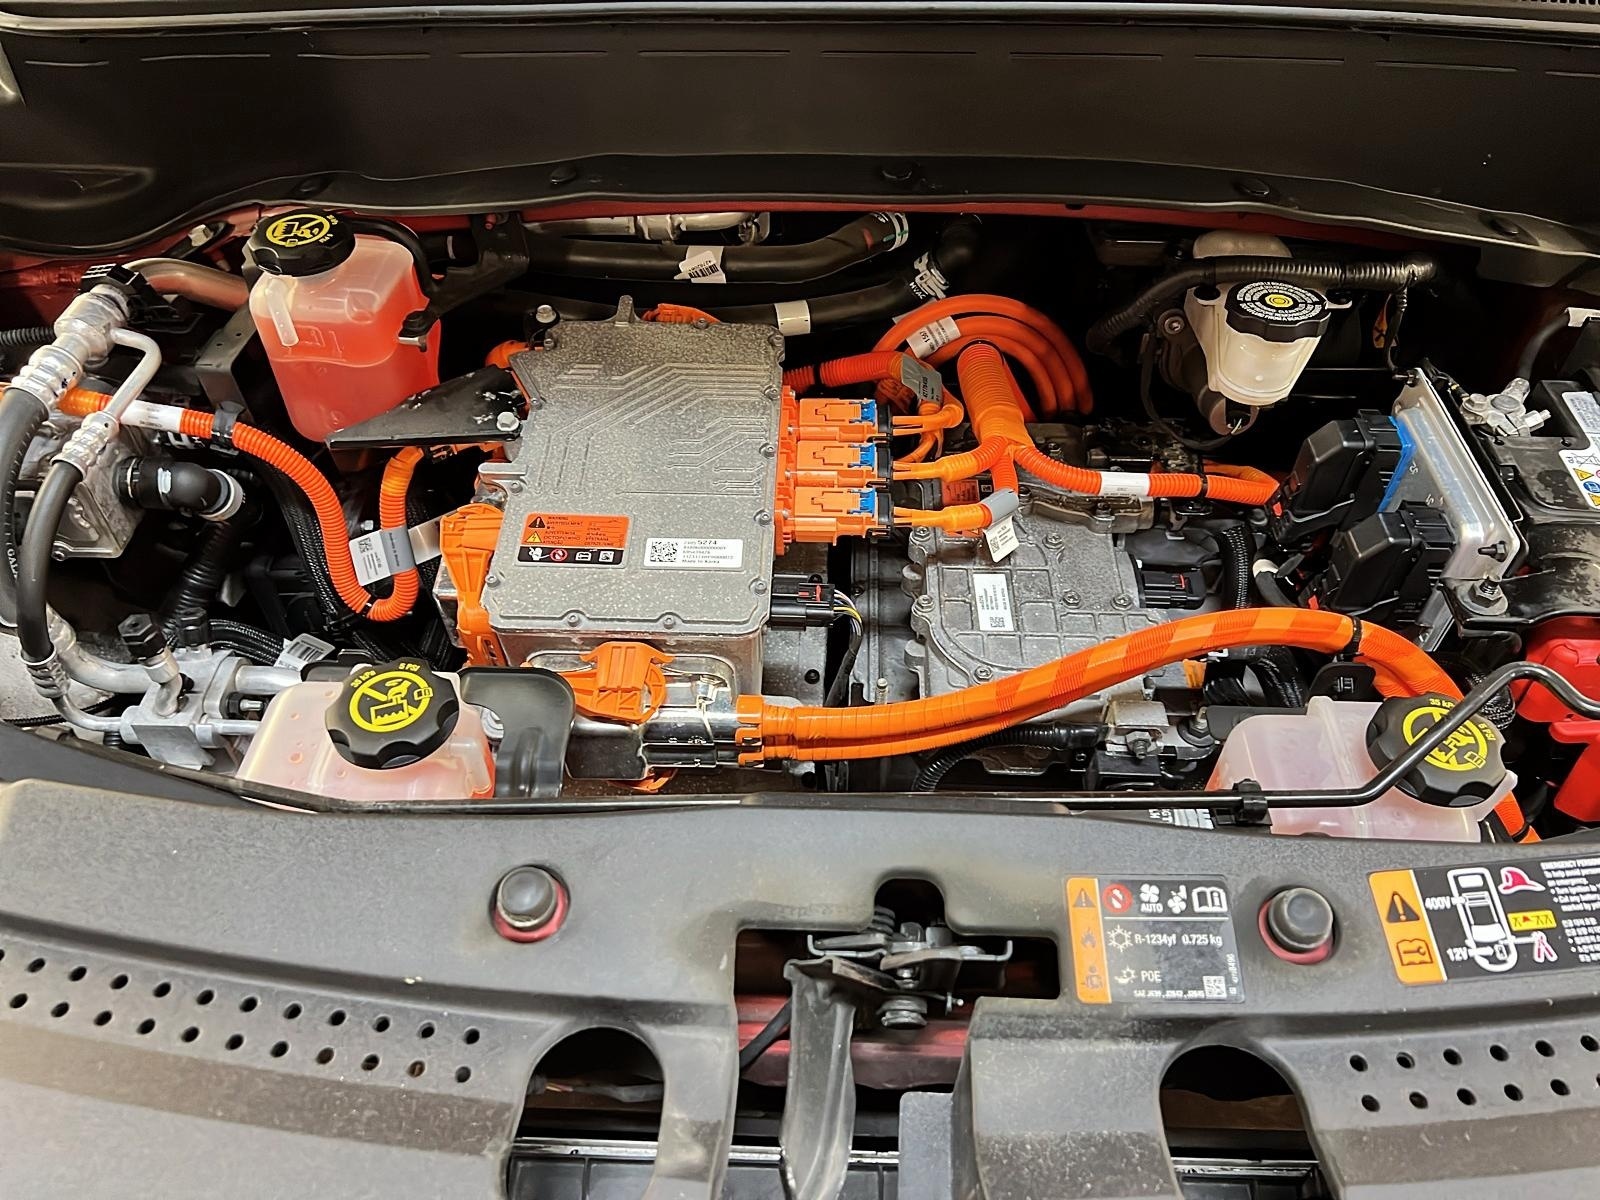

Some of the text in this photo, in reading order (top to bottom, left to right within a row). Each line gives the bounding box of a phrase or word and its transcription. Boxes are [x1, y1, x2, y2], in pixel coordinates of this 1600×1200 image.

[405, 663, 420, 672] PSI
[1441, 700, 1455, 709] kP
[1482, 728, 1497, 741] PSI
[1140, 903, 1163, 913] AUTO
[1425, 896, 1451, 911] 400V
[1134, 933, 1223, 949] R-1234yf 0.725 kg
[1446, 946, 1468, 962] 12V
[1140, 970, 1162, 983] POE
